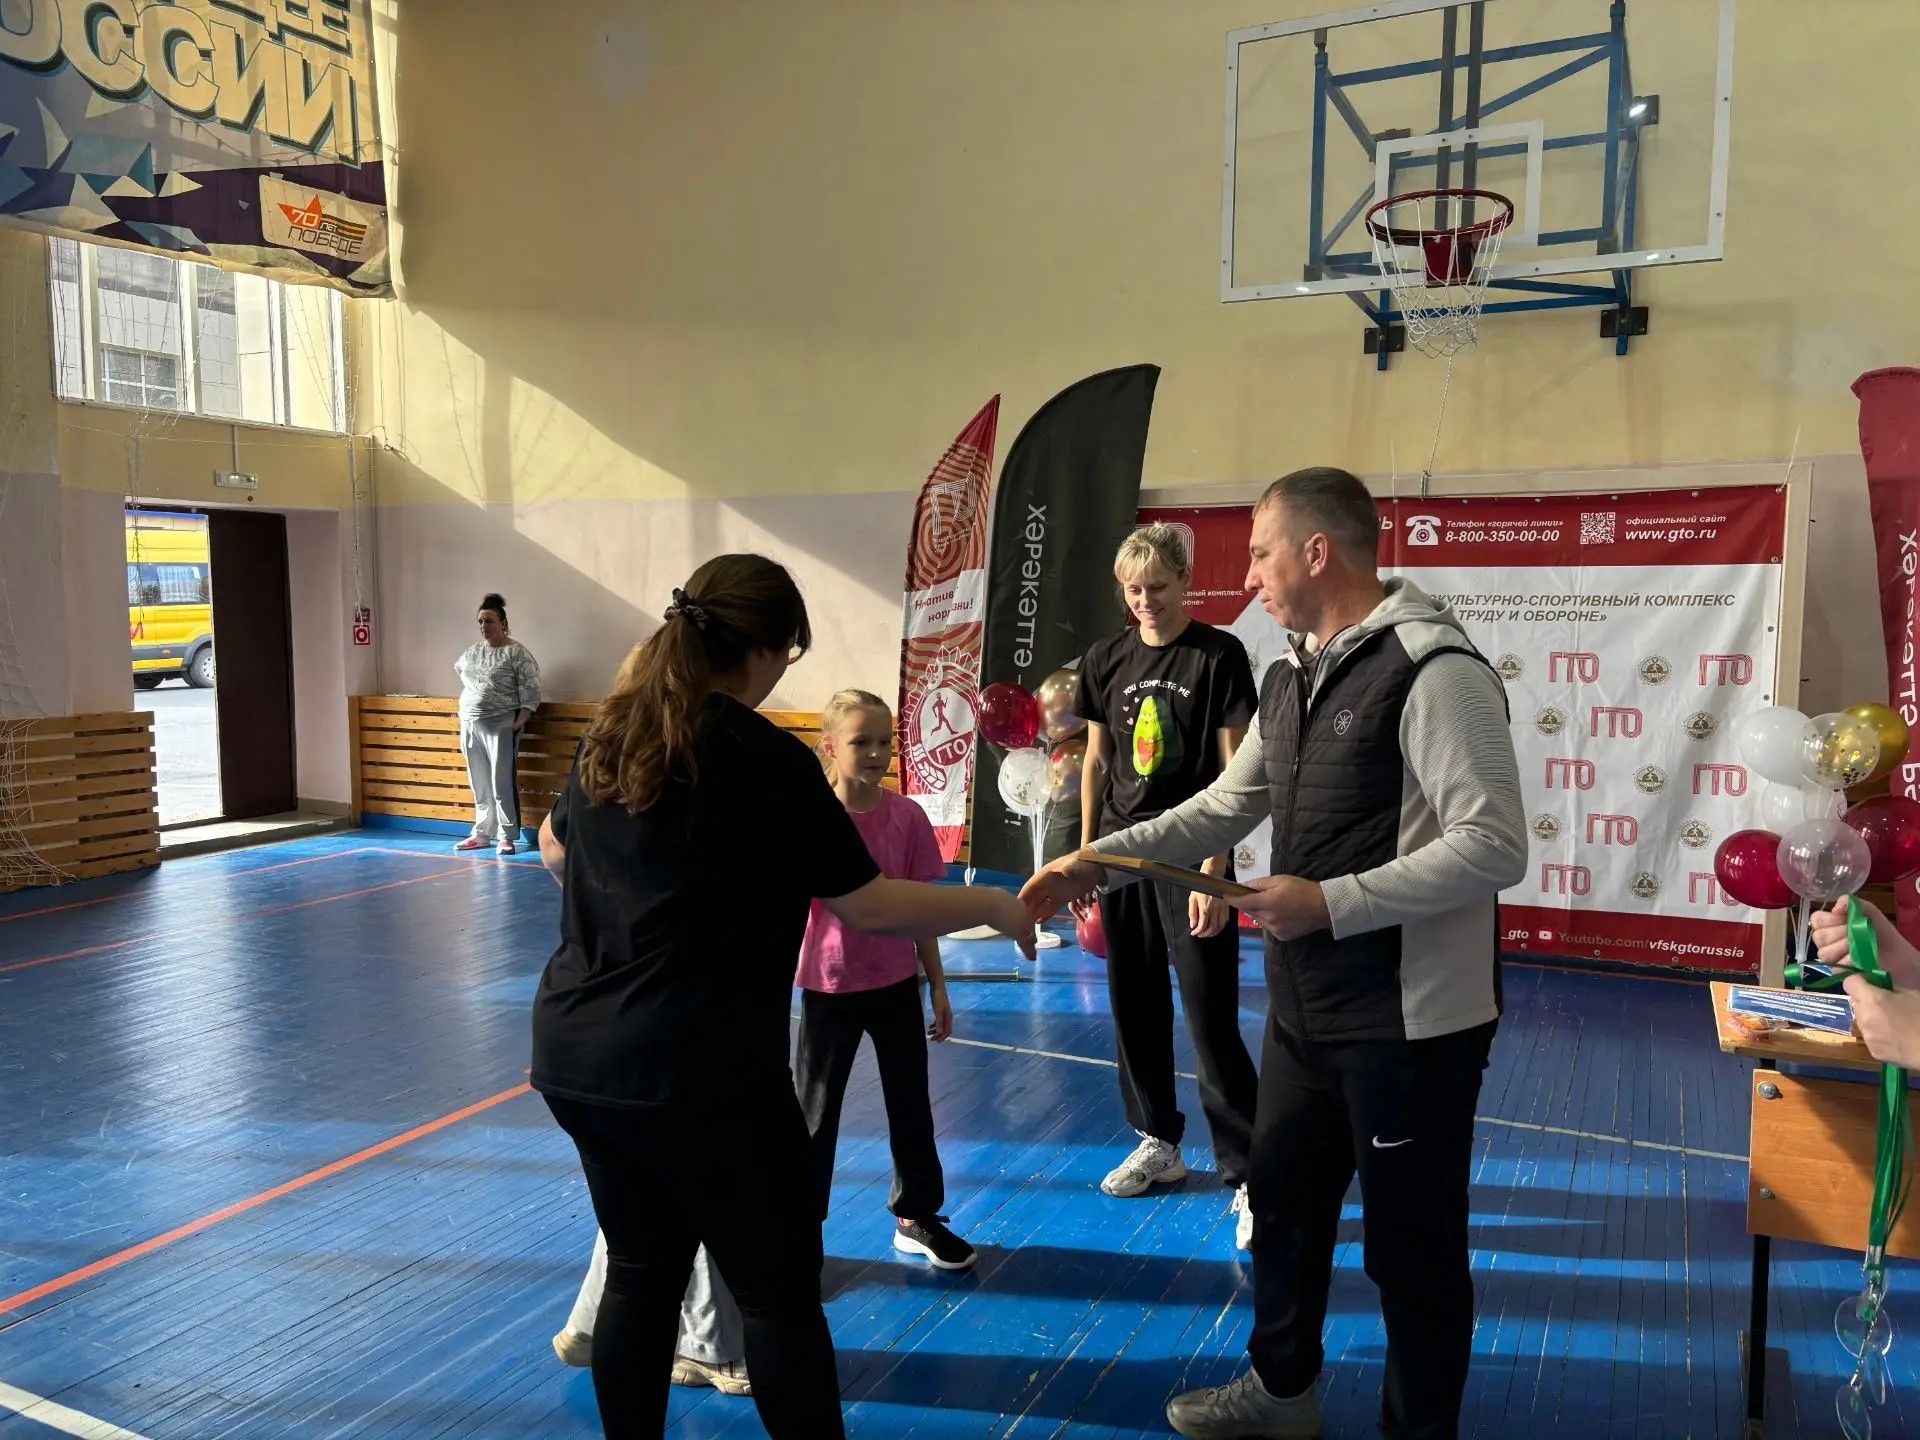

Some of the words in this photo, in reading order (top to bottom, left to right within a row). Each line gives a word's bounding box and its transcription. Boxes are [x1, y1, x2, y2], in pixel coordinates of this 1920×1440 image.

[0, 0, 361, 169] ОССИИ
[291, 208, 319, 228] 70
[288, 226, 362, 255] ПОБЕДЕ
[1446, 520, 1485, 528] Телефон
[1626, 515, 1697, 525] официальный
[1700, 515, 1727, 523] сайт
[1445, 530, 1560, 542] 8-800-350-00-00
[1625, 528, 1717, 542] www.gto.ru
[1430, 593, 1641, 606] ЗКУЛЬТУРНО-СПОРТИВНЫЙ
[1644, 595, 1735, 606] КОМПЛЕКС
[1459, 610, 1506, 623] ТРУДУ
[1509, 610, 1520, 621] И
[1523, 610, 1607, 622] ОБОРОНЕ»
[1549, 651, 1600, 683] ГТО
[1698, 653, 1753, 686] ГТО
[1123, 684, 1137, 696] YOU
[1140, 679, 1177, 691] COMPLETE
[1178, 686, 1191, 698] ME
[1590, 706, 1643, 738] ГТО
[935, 738, 968, 764] ГТО
[1545, 757, 1596, 790] ГТО
[1692, 763, 1747, 796] ГТО
[1586, 813, 1639, 846] ГТО
[1541, 863, 1592, 896] ГТО
